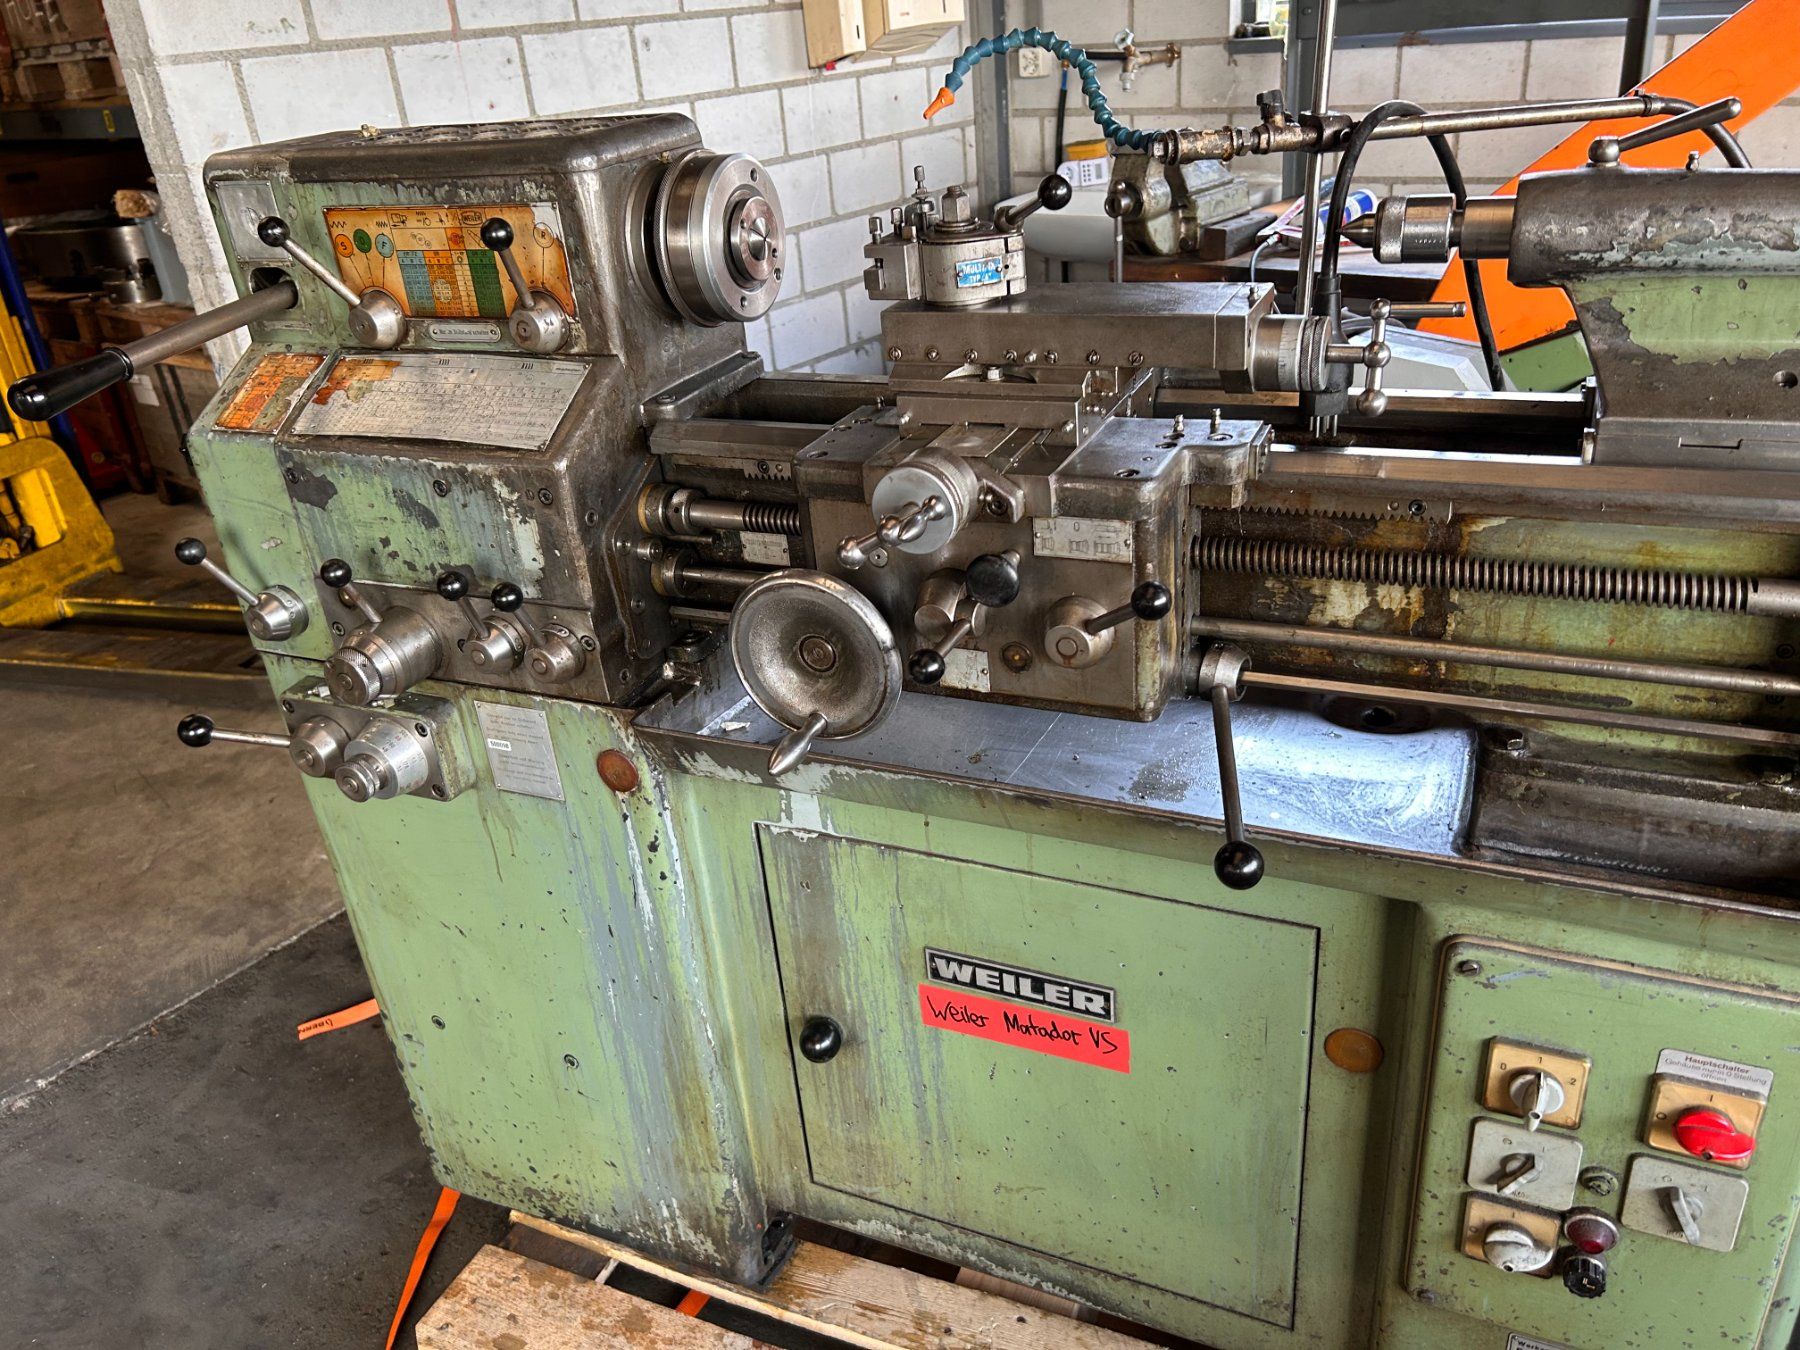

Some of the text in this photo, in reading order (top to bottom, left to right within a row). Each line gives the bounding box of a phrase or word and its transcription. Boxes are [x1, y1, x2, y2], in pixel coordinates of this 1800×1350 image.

[933, 957, 1106, 1015] WEILER
[927, 995, 990, 1027] Weiler
[1003, 1010, 1082, 1045] Matador
[1685, 1055, 1751, 1074] Hauptschalter
[1733, 1072, 1767, 1086] Stellung
